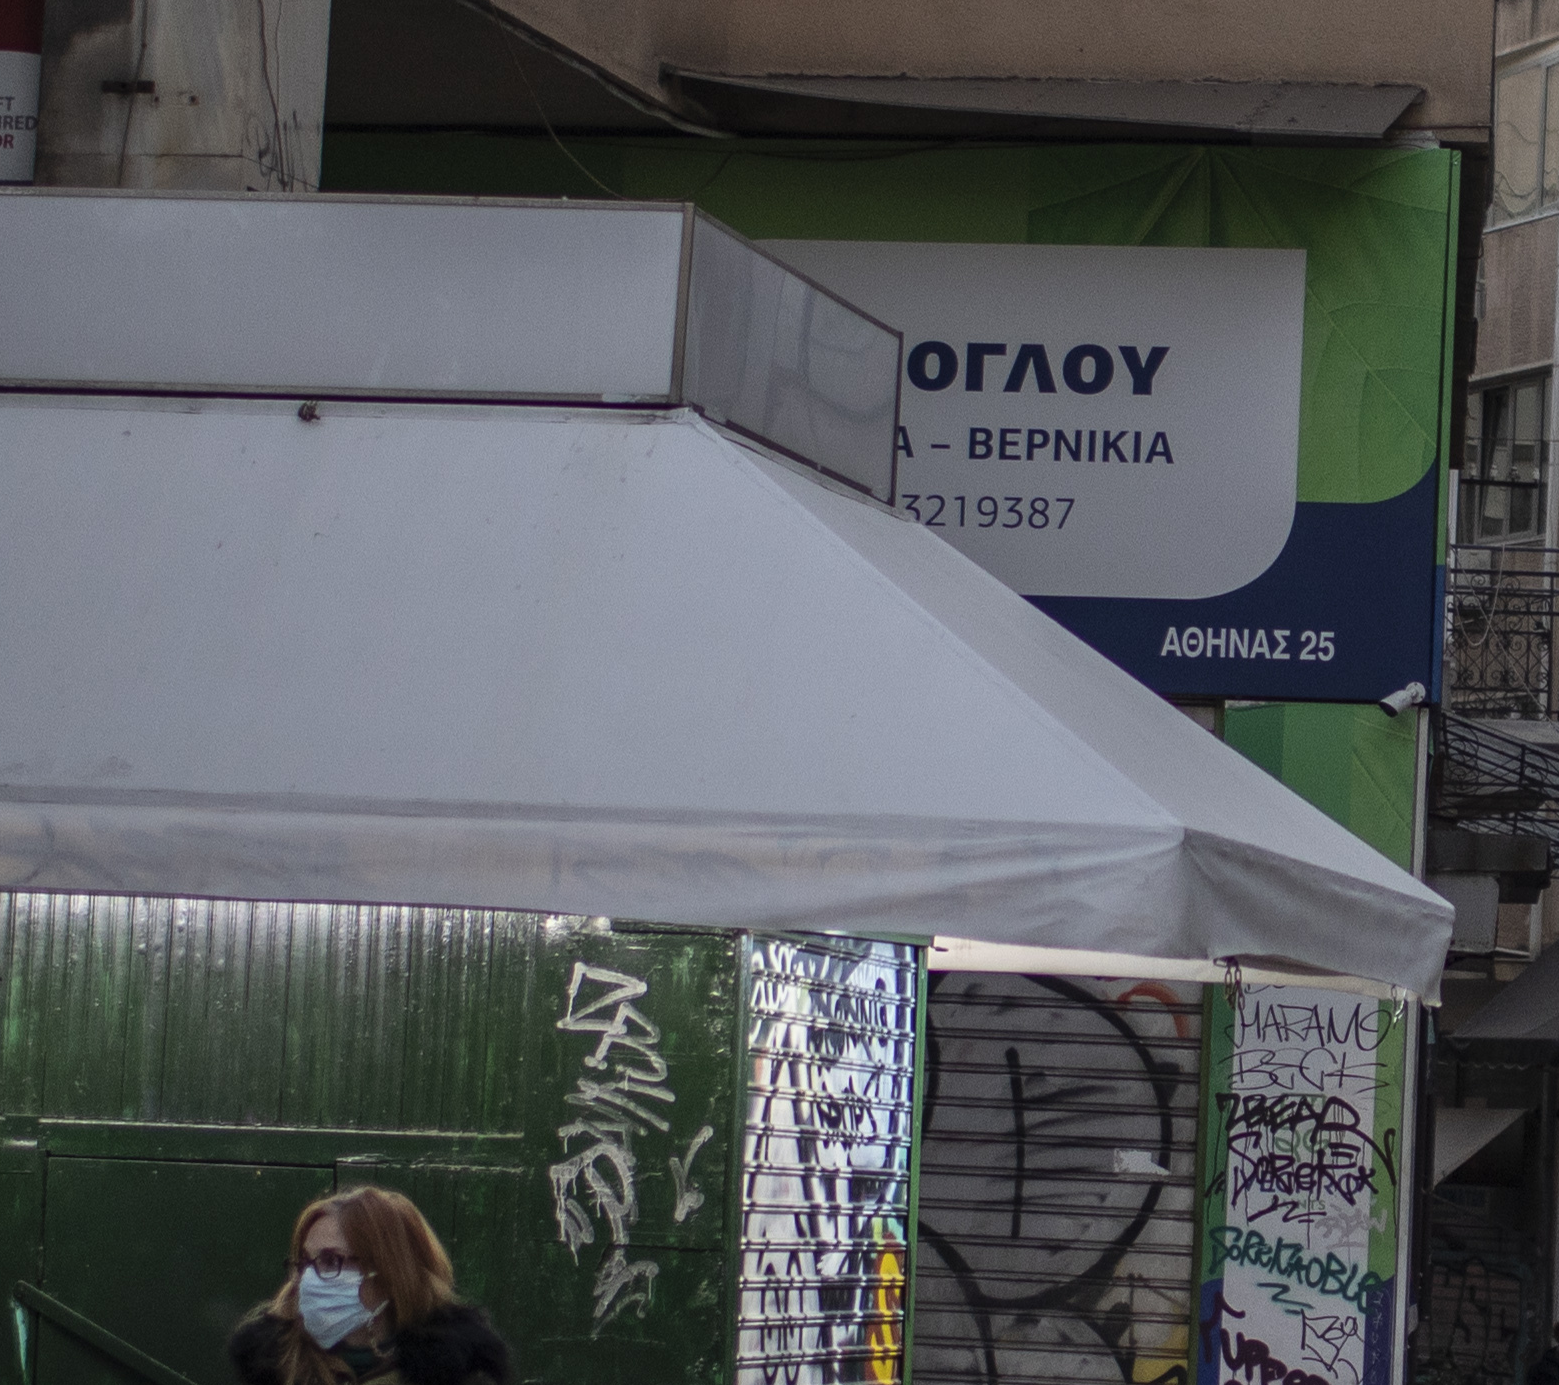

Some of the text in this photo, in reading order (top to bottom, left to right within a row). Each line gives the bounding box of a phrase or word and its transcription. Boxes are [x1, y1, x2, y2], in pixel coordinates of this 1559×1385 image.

[967, 427, 1175, 464] ΒΕΡΝΙΚΙΑ
[900, 492, 1076, 530] 3219387
[1160, 626, 1336, 662] ΑΘΗΝΑΣ 25
